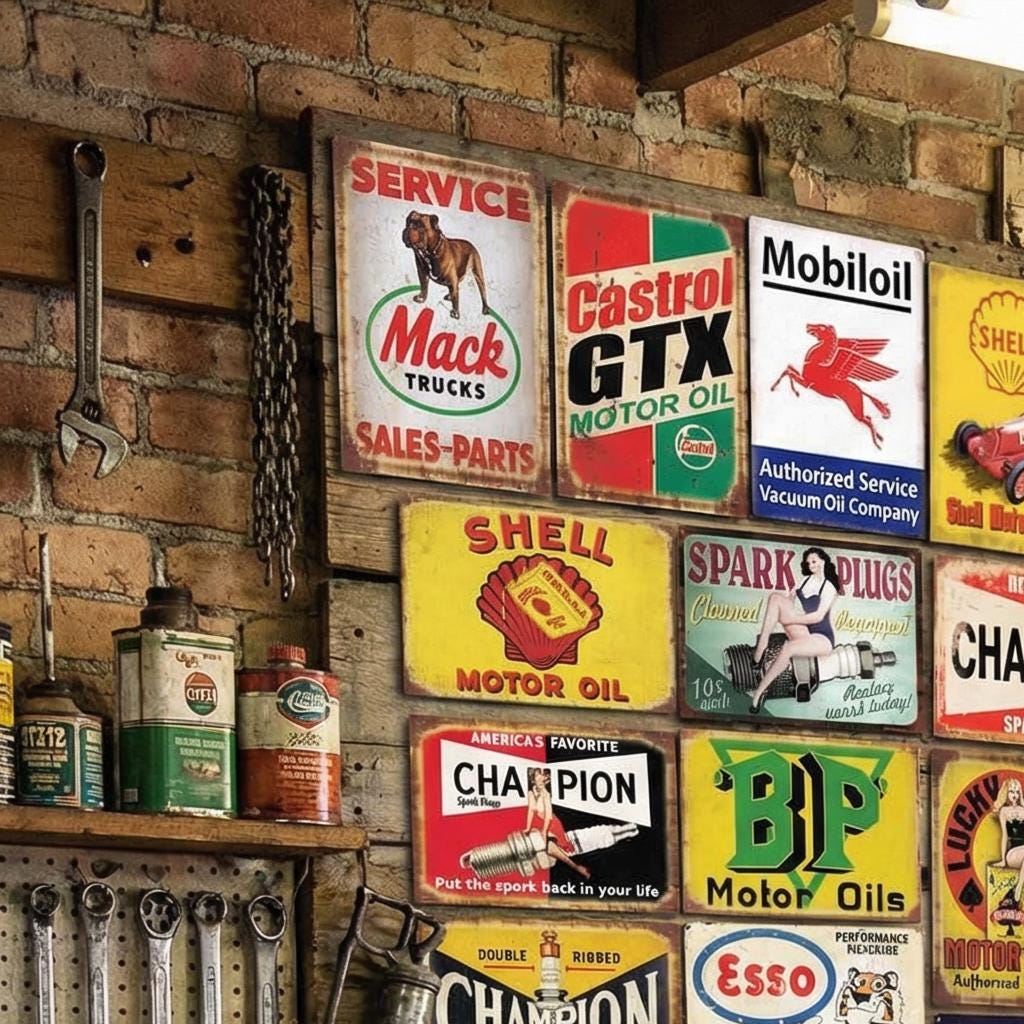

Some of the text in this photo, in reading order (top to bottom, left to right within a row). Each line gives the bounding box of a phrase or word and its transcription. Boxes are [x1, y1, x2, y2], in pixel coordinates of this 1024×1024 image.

[351, 157, 532, 223] SERVICE
[762, 236, 912, 301] Mobiloil
[567, 257, 733, 334] Castrol
[380, 305, 508, 379] Mack
[568, 311, 734, 405] GTX
[405, 373, 486, 400] TRUCKS
[569, 383, 735, 437] MOTOR OIL
[759, 458, 919, 498] Authorized Service
[759, 484, 920, 528] Vacuum Oil Company
[464, 512, 614, 567] SHELL
[687, 541, 913, 602] SPARK PLUGS
[457, 668, 630, 702] MOTOR OIL
[551, 736, 619, 753] FAVORITE
[435, 877, 462, 890] Put
[464, 878, 491, 891] the
[542, 880, 576, 895] back
[580, 883, 593, 895] in
[598, 884, 632, 898] your
[636, 884, 659, 898] life
[707, 877, 905, 912] Motor Oils
[478, 949, 620, 964] DOUBLE RIBBED
[943, 938, 1022, 973] MOTOR
